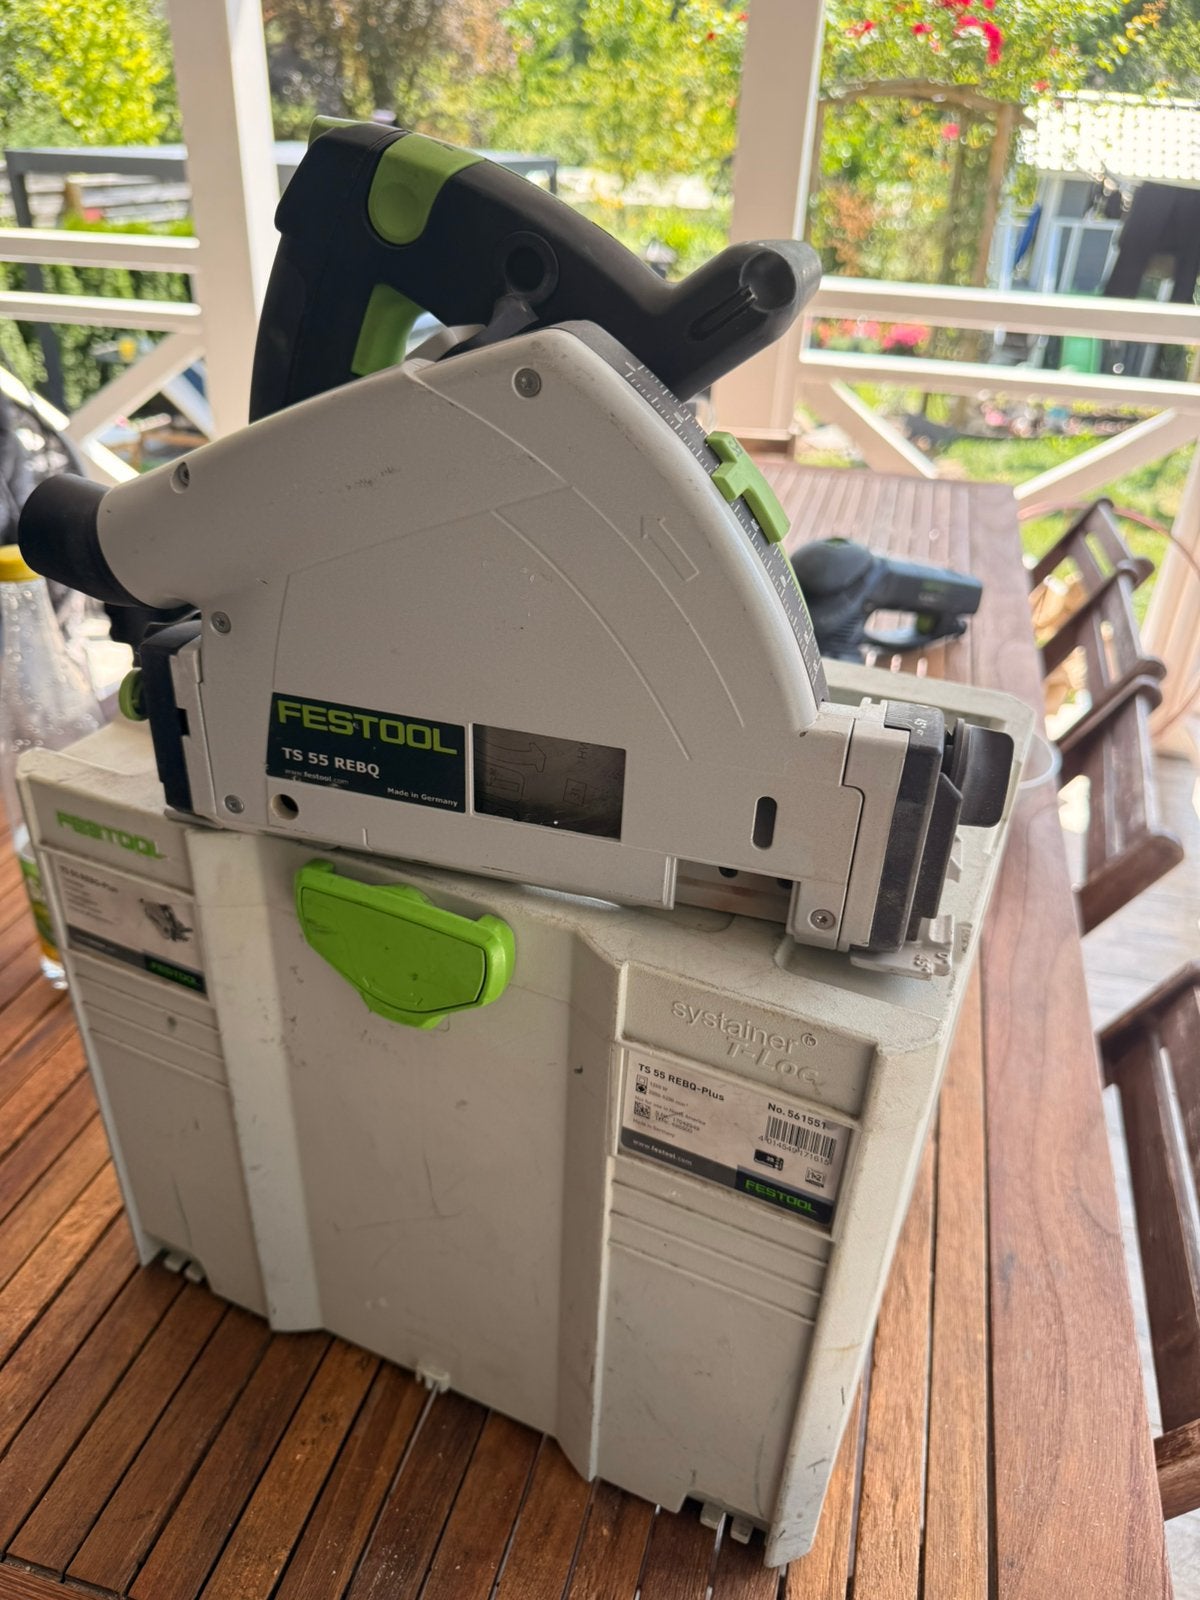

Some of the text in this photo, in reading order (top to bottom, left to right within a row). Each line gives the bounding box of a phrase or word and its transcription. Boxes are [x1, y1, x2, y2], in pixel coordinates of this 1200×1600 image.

[278, 700, 458, 755] FESTOOL
[281, 747, 381, 779] TS 55 REBQ
[387, 787, 458, 808] Made in Germany
[638, 1063, 651, 1074] TS
[653, 1069, 666, 1080] 55
[668, 1074, 725, 1101] REBQ-Plus
[767, 1102, 827, 1130] No. 561551
[744, 1178, 817, 1214] FESTOOL
